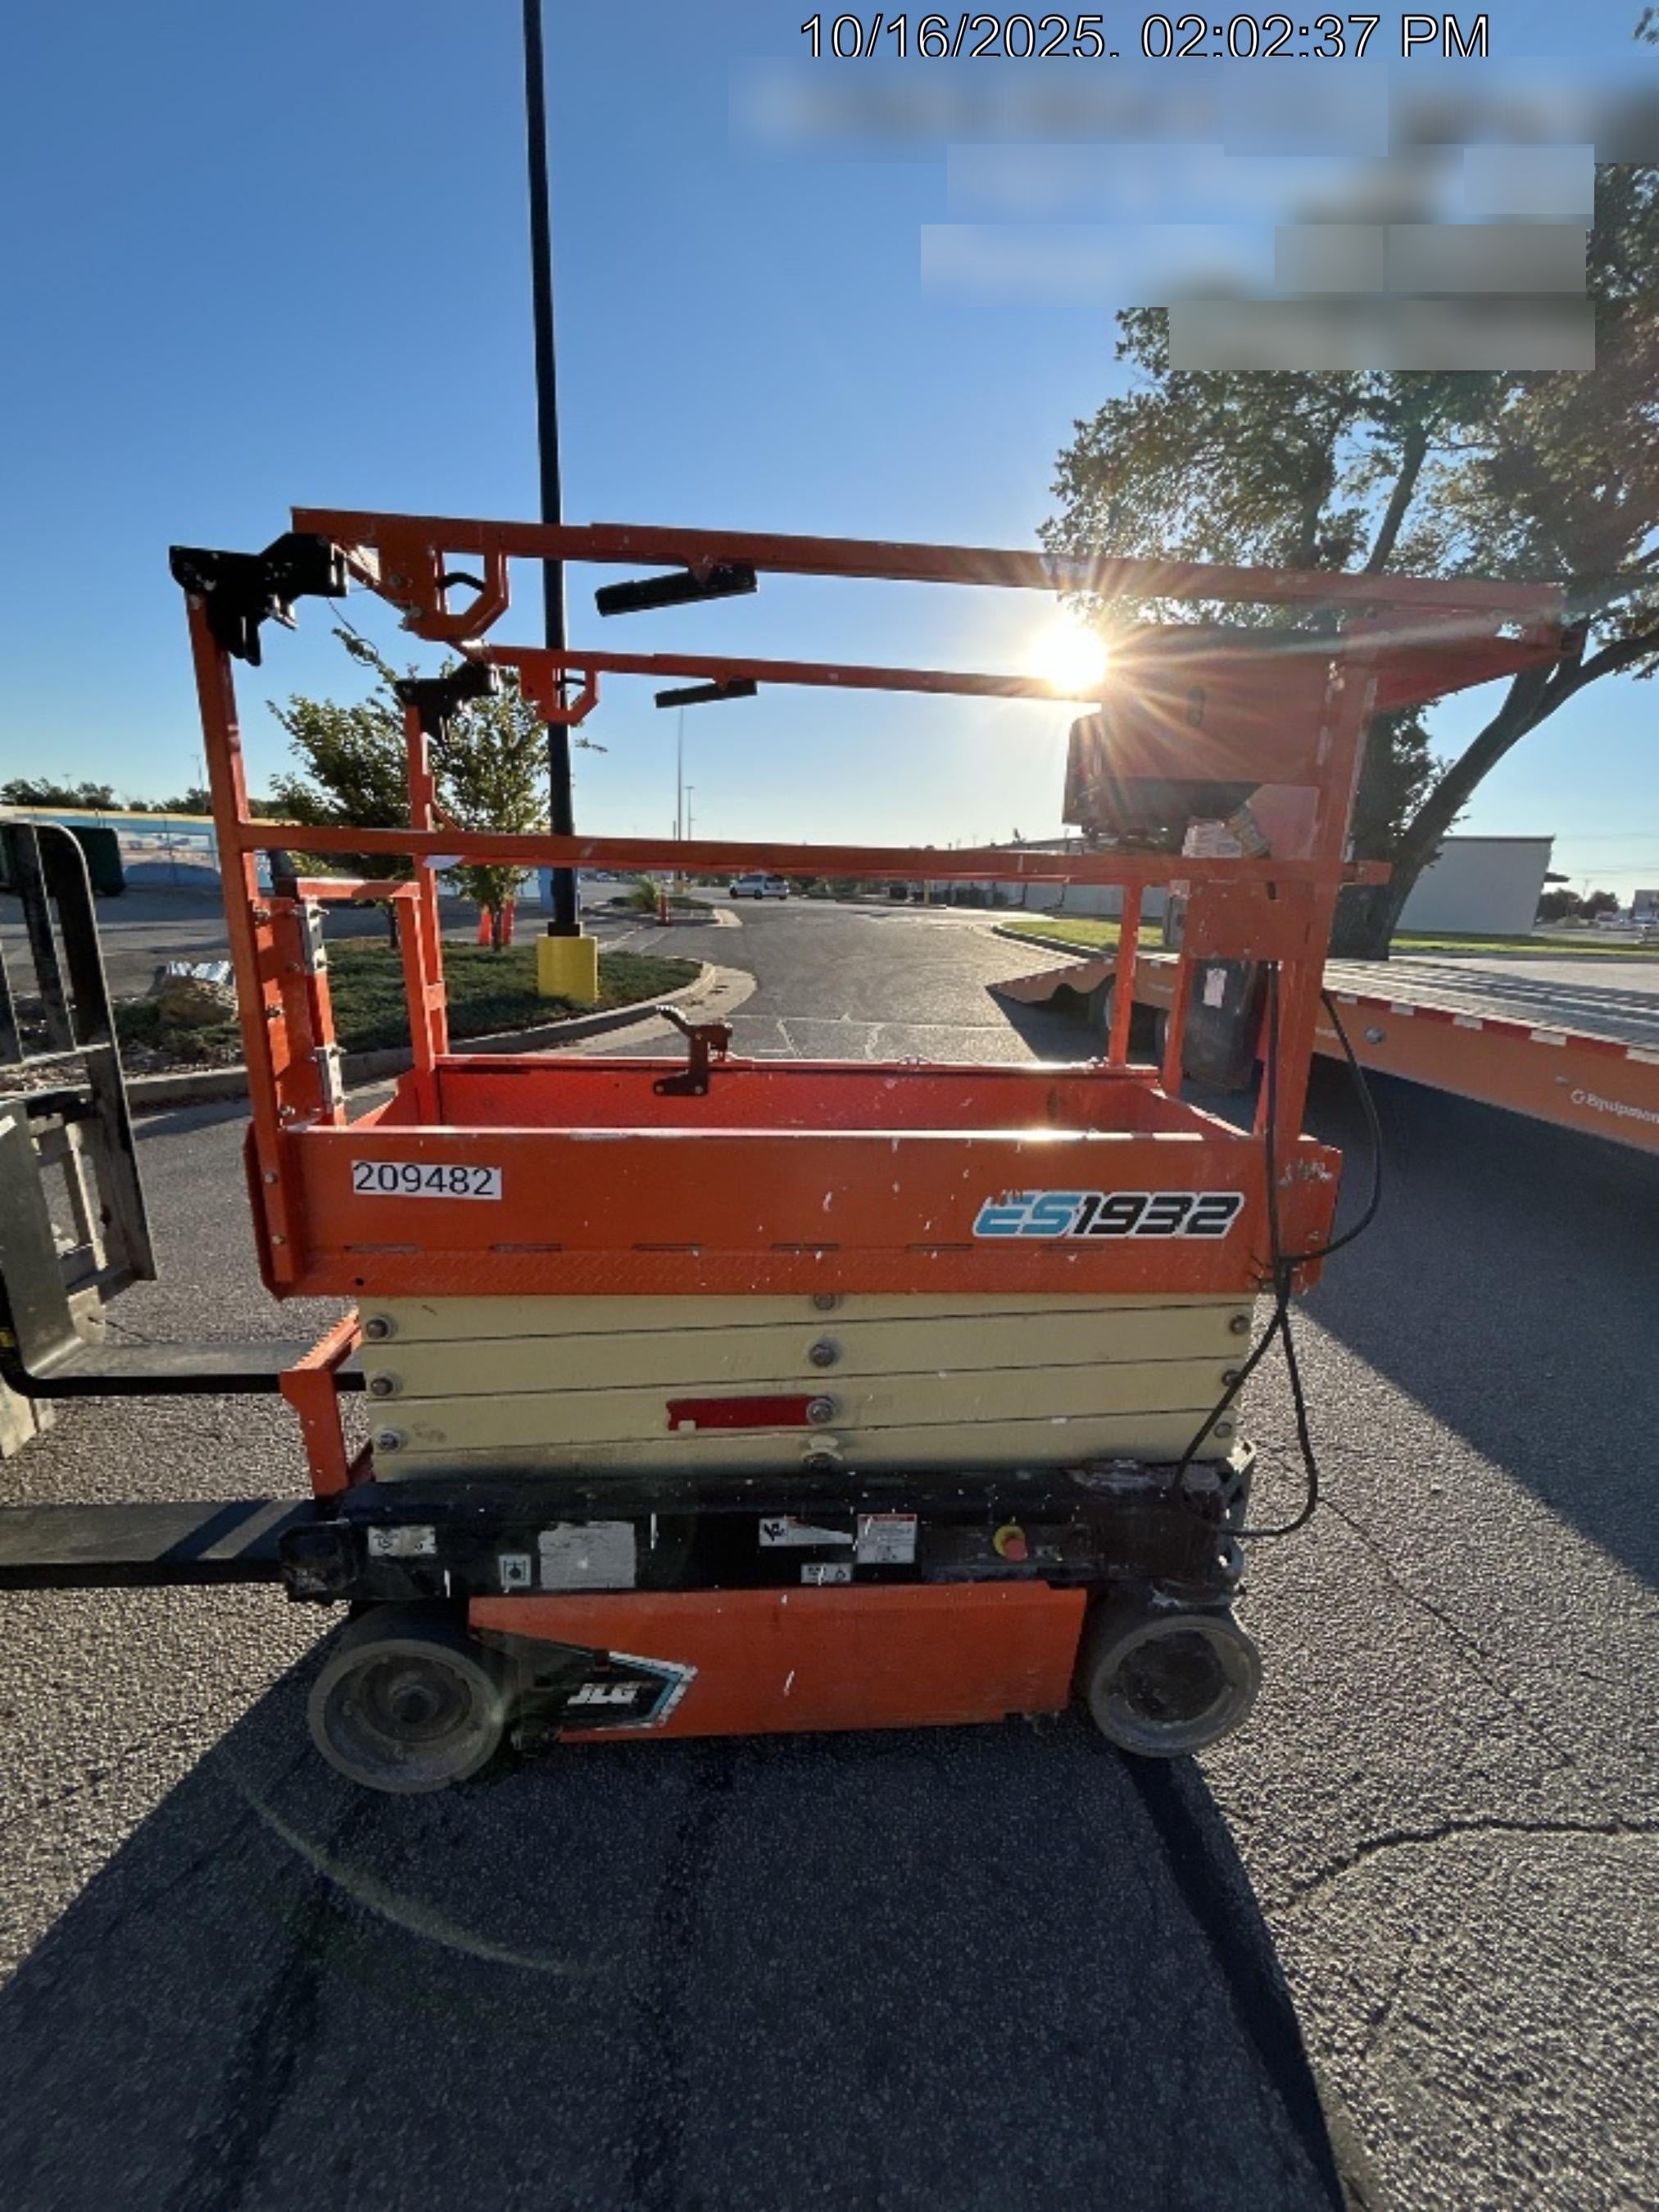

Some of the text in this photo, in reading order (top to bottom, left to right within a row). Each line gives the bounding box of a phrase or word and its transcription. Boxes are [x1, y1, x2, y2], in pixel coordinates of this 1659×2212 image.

[353, 1162, 495, 1195] 209482
[975, 1190, 1243, 1237] ES1932
[567, 1682, 645, 1705] JLG
